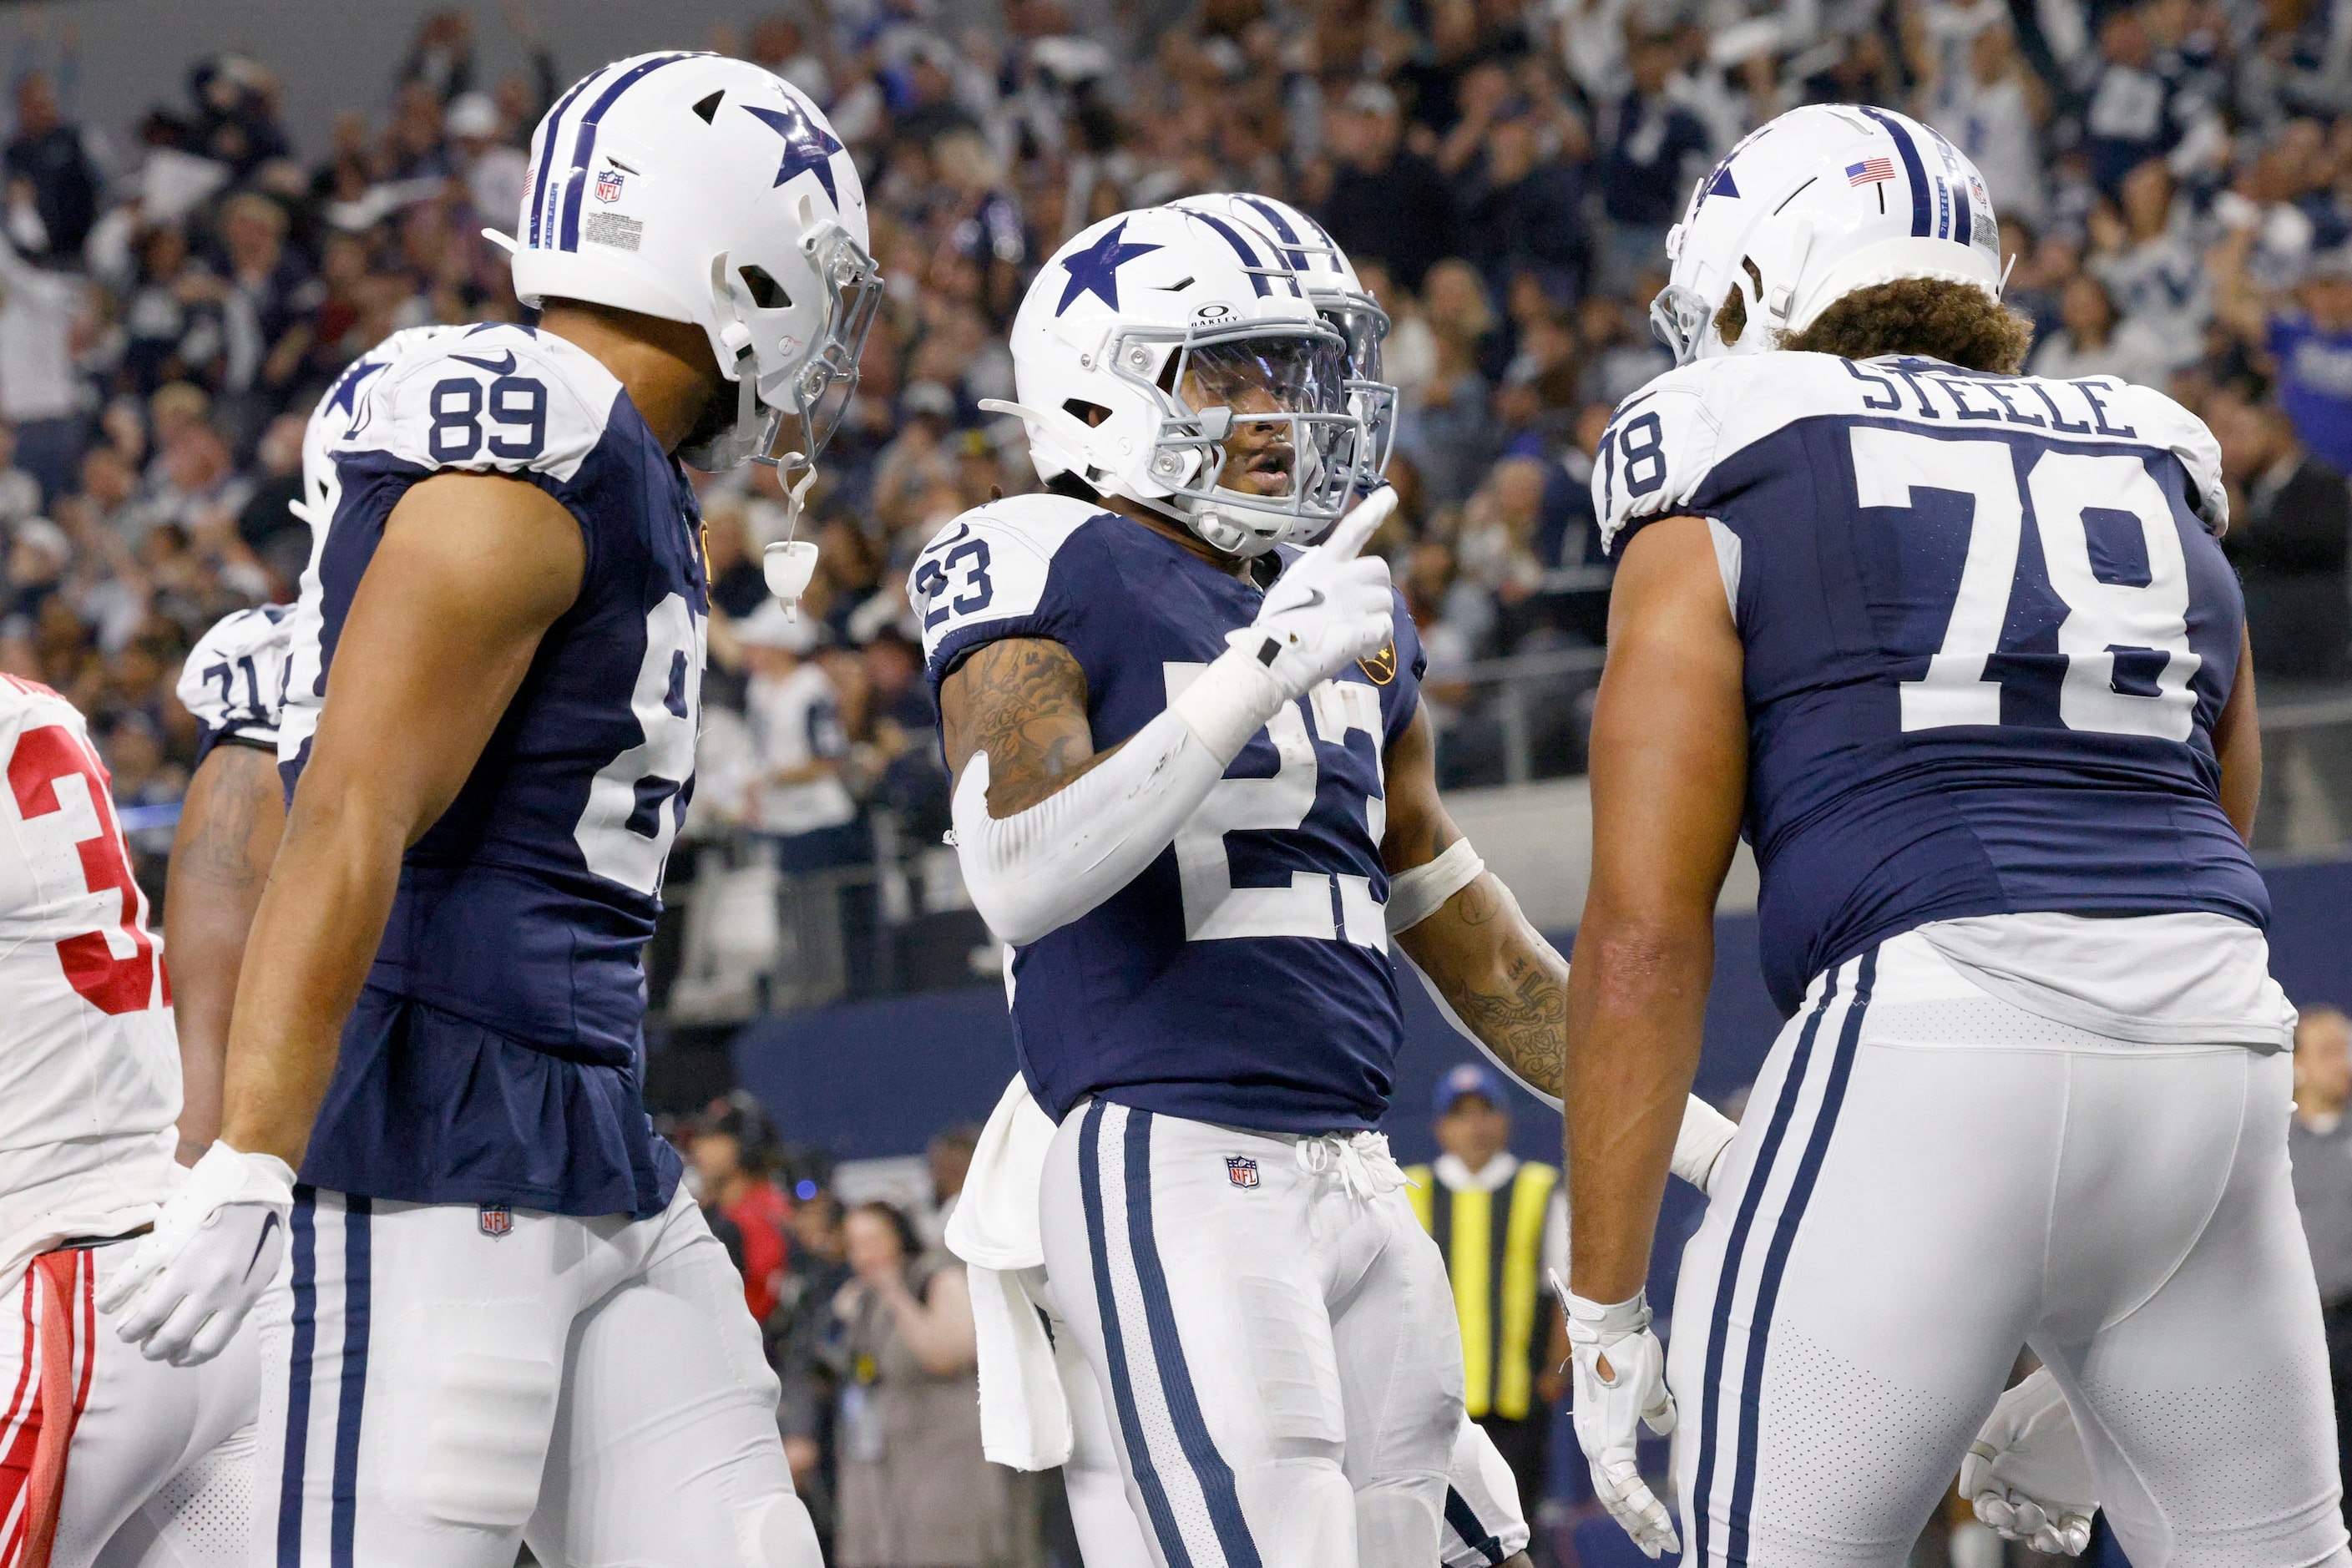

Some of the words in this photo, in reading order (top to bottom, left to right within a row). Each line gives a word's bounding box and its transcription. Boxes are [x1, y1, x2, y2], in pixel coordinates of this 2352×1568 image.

[597, 182, 618, 200] NFL
[429, 377, 547, 463] 89
[1840, 357, 2137, 439] STEELE
[915, 539, 994, 635] 23
[1849, 426, 2202, 742] 78
[203, 655, 269, 718] 71
[7, 725, 174, 1016] 3
[1231, 1168, 1257, 1185] NFL
[483, 1212, 509, 1232] NFL
